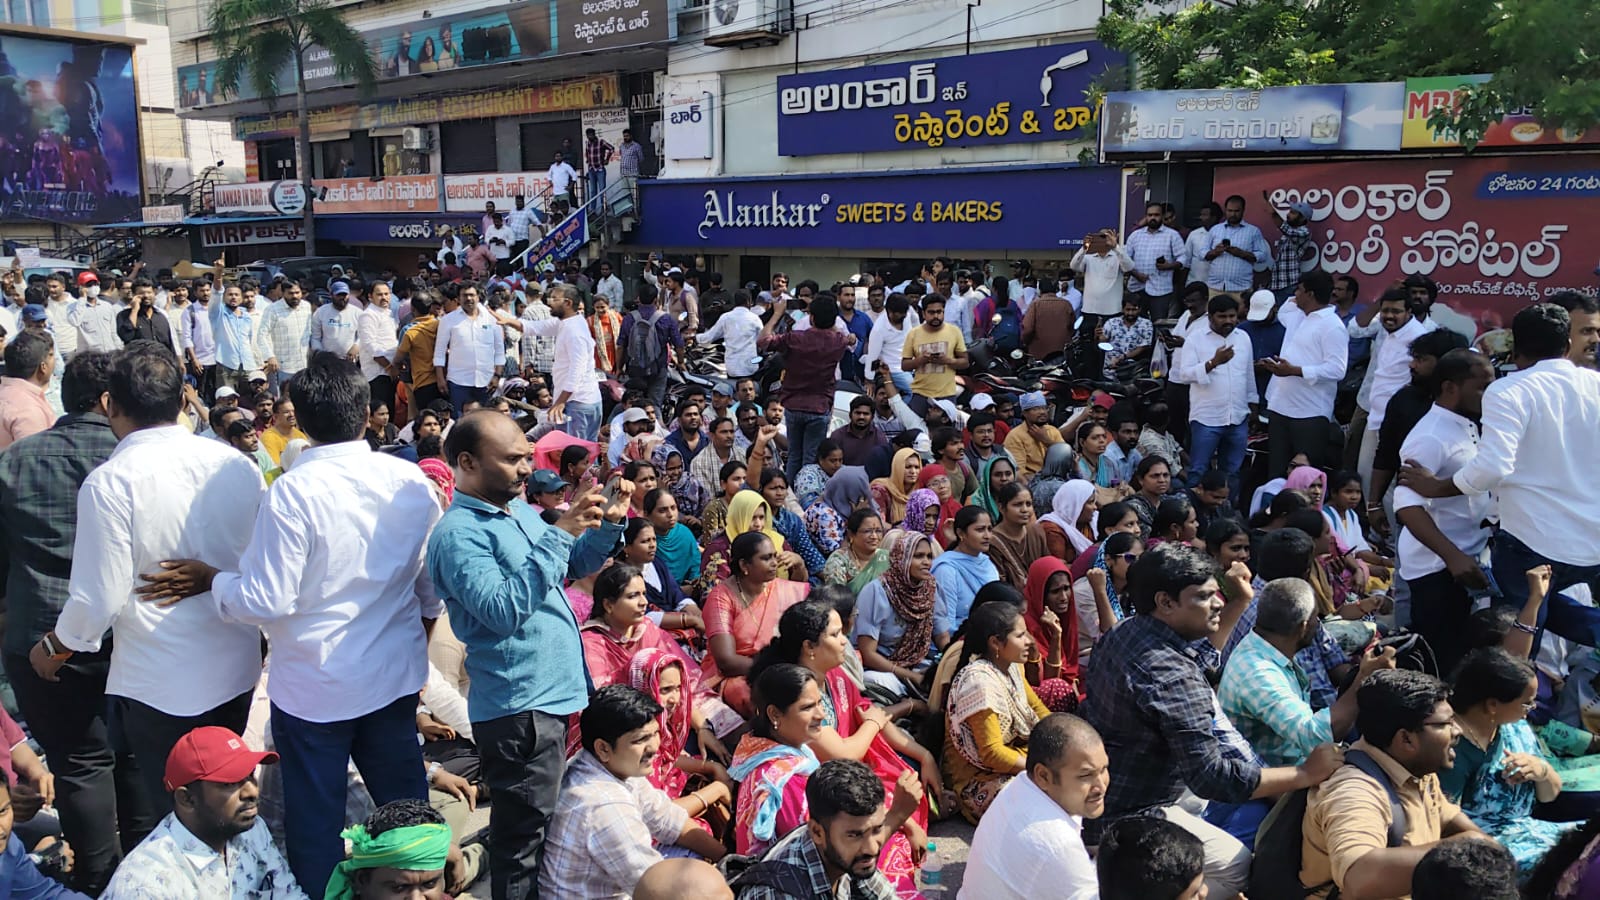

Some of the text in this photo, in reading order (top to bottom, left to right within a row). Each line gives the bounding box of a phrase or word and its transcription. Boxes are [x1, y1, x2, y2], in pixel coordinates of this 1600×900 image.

[617, 17, 627, 32] &
[629, 10, 649, 30] బార్
[552, 83, 586, 107] BAR
[781, 63, 967, 115] అలంకార్ ఇన్
[671, 105, 702, 124] బార్
[894, 101, 1098, 147] రెస్టారెంట్ & బా
[1142, 116, 1185, 139] బార్
[1488, 174, 1600, 193] భోజనం 24 గంట
[1269, 170, 1453, 221] అలంకార్
[835, 202, 906, 223] SWEETS
[912, 202, 924, 223] &
[931, 200, 1003, 223] BAKERS
[204, 224, 253, 244] MRP
[389, 220, 432, 238] అలంకార్
[1400, 221, 1568, 277] హోటల్
